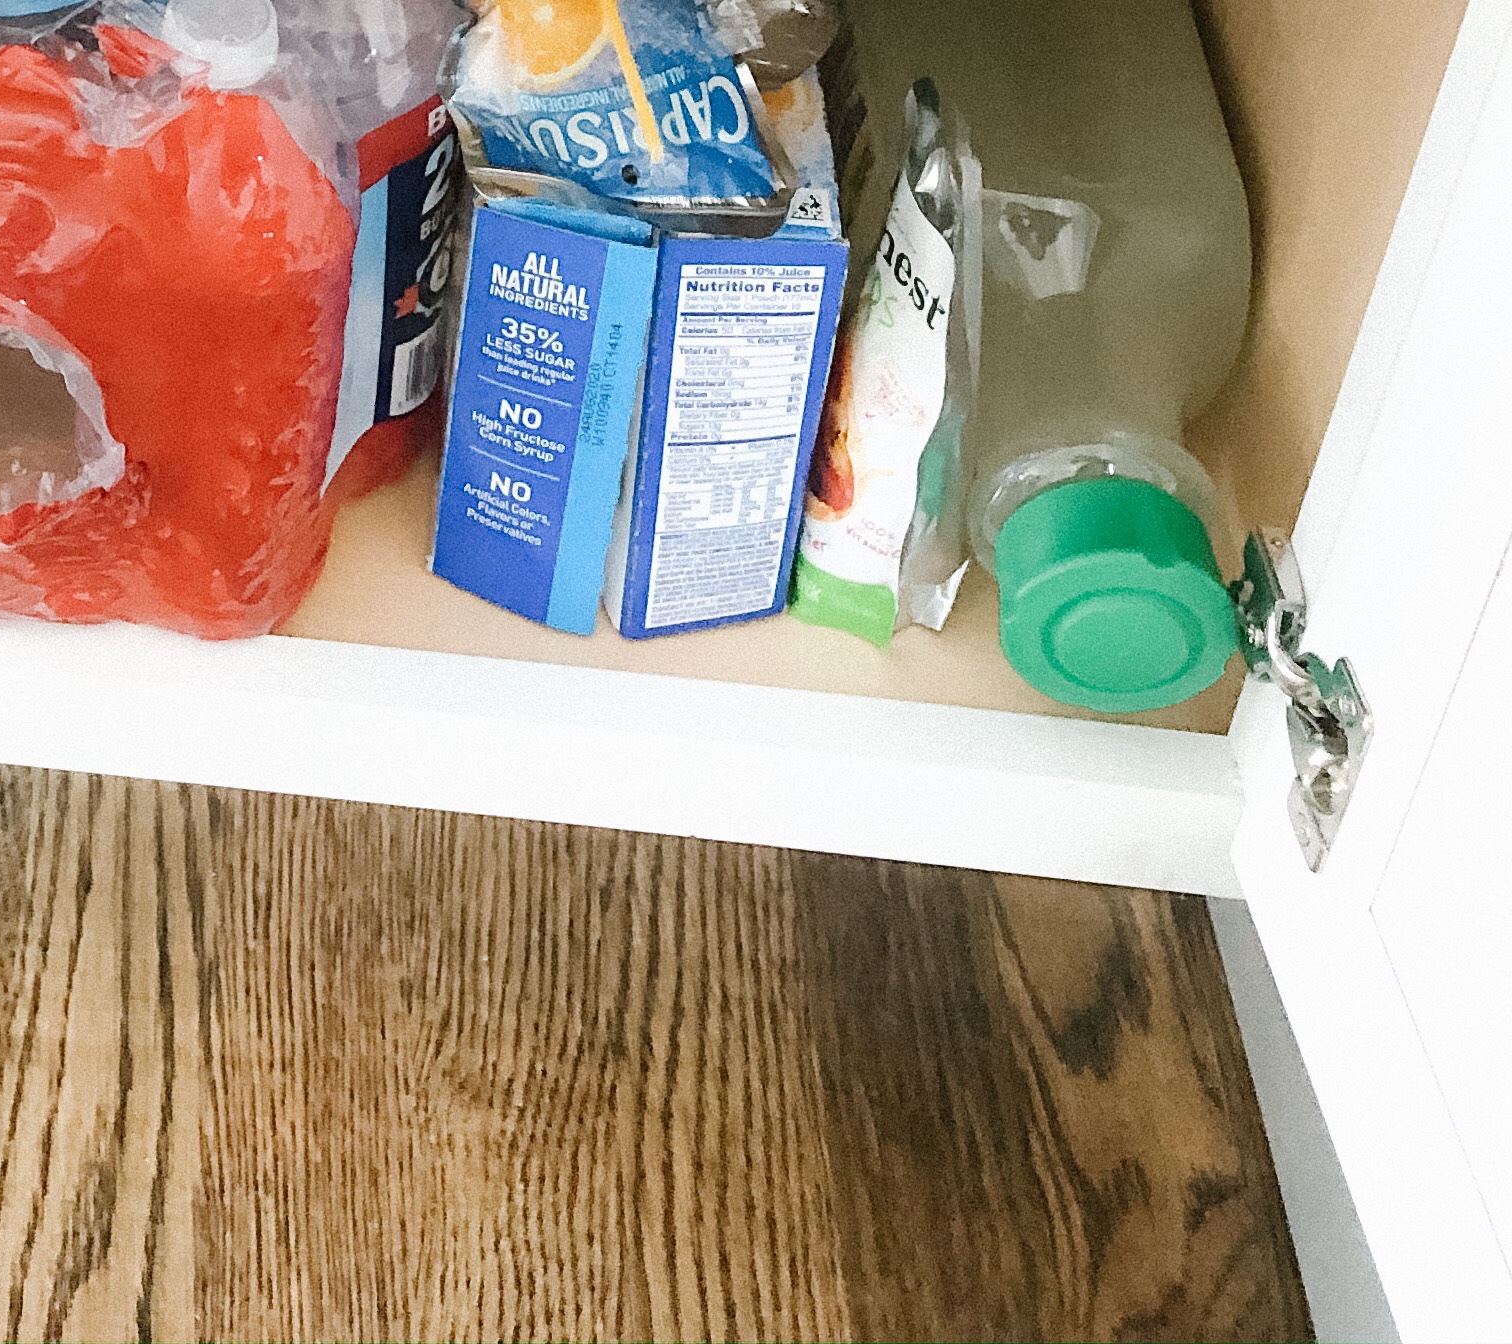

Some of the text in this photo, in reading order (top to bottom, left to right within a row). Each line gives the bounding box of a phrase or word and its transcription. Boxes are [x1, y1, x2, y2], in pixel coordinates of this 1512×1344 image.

[522, 251, 564, 280] ALL
[695, 266, 812, 278] Contains 10% Juice
[488, 283, 590, 322] INGREDIENTS
[490, 263, 591, 311] NATURAL
[686, 280, 820, 294] Nutrition Facts
[500, 316, 565, 355] 35%
[681, 326, 719, 335] Calories
[481, 345, 577, 383] than leading regular
[485, 333, 576, 371] LESS SUGAR
[496, 363, 521, 377] juice
[675, 379, 727, 389] Cholesterol
[498, 397, 543, 430] NO
[471, 410, 567, 454] High Fructose
[478, 427, 556, 465] Corn Syrup
[670, 431, 710, 442] Protein
[488, 470, 533, 504] NO
[463, 482, 552, 528] Artificial Colors,
[477, 499, 535, 531] Flavors or
[465, 507, 544, 547] Preservatives
